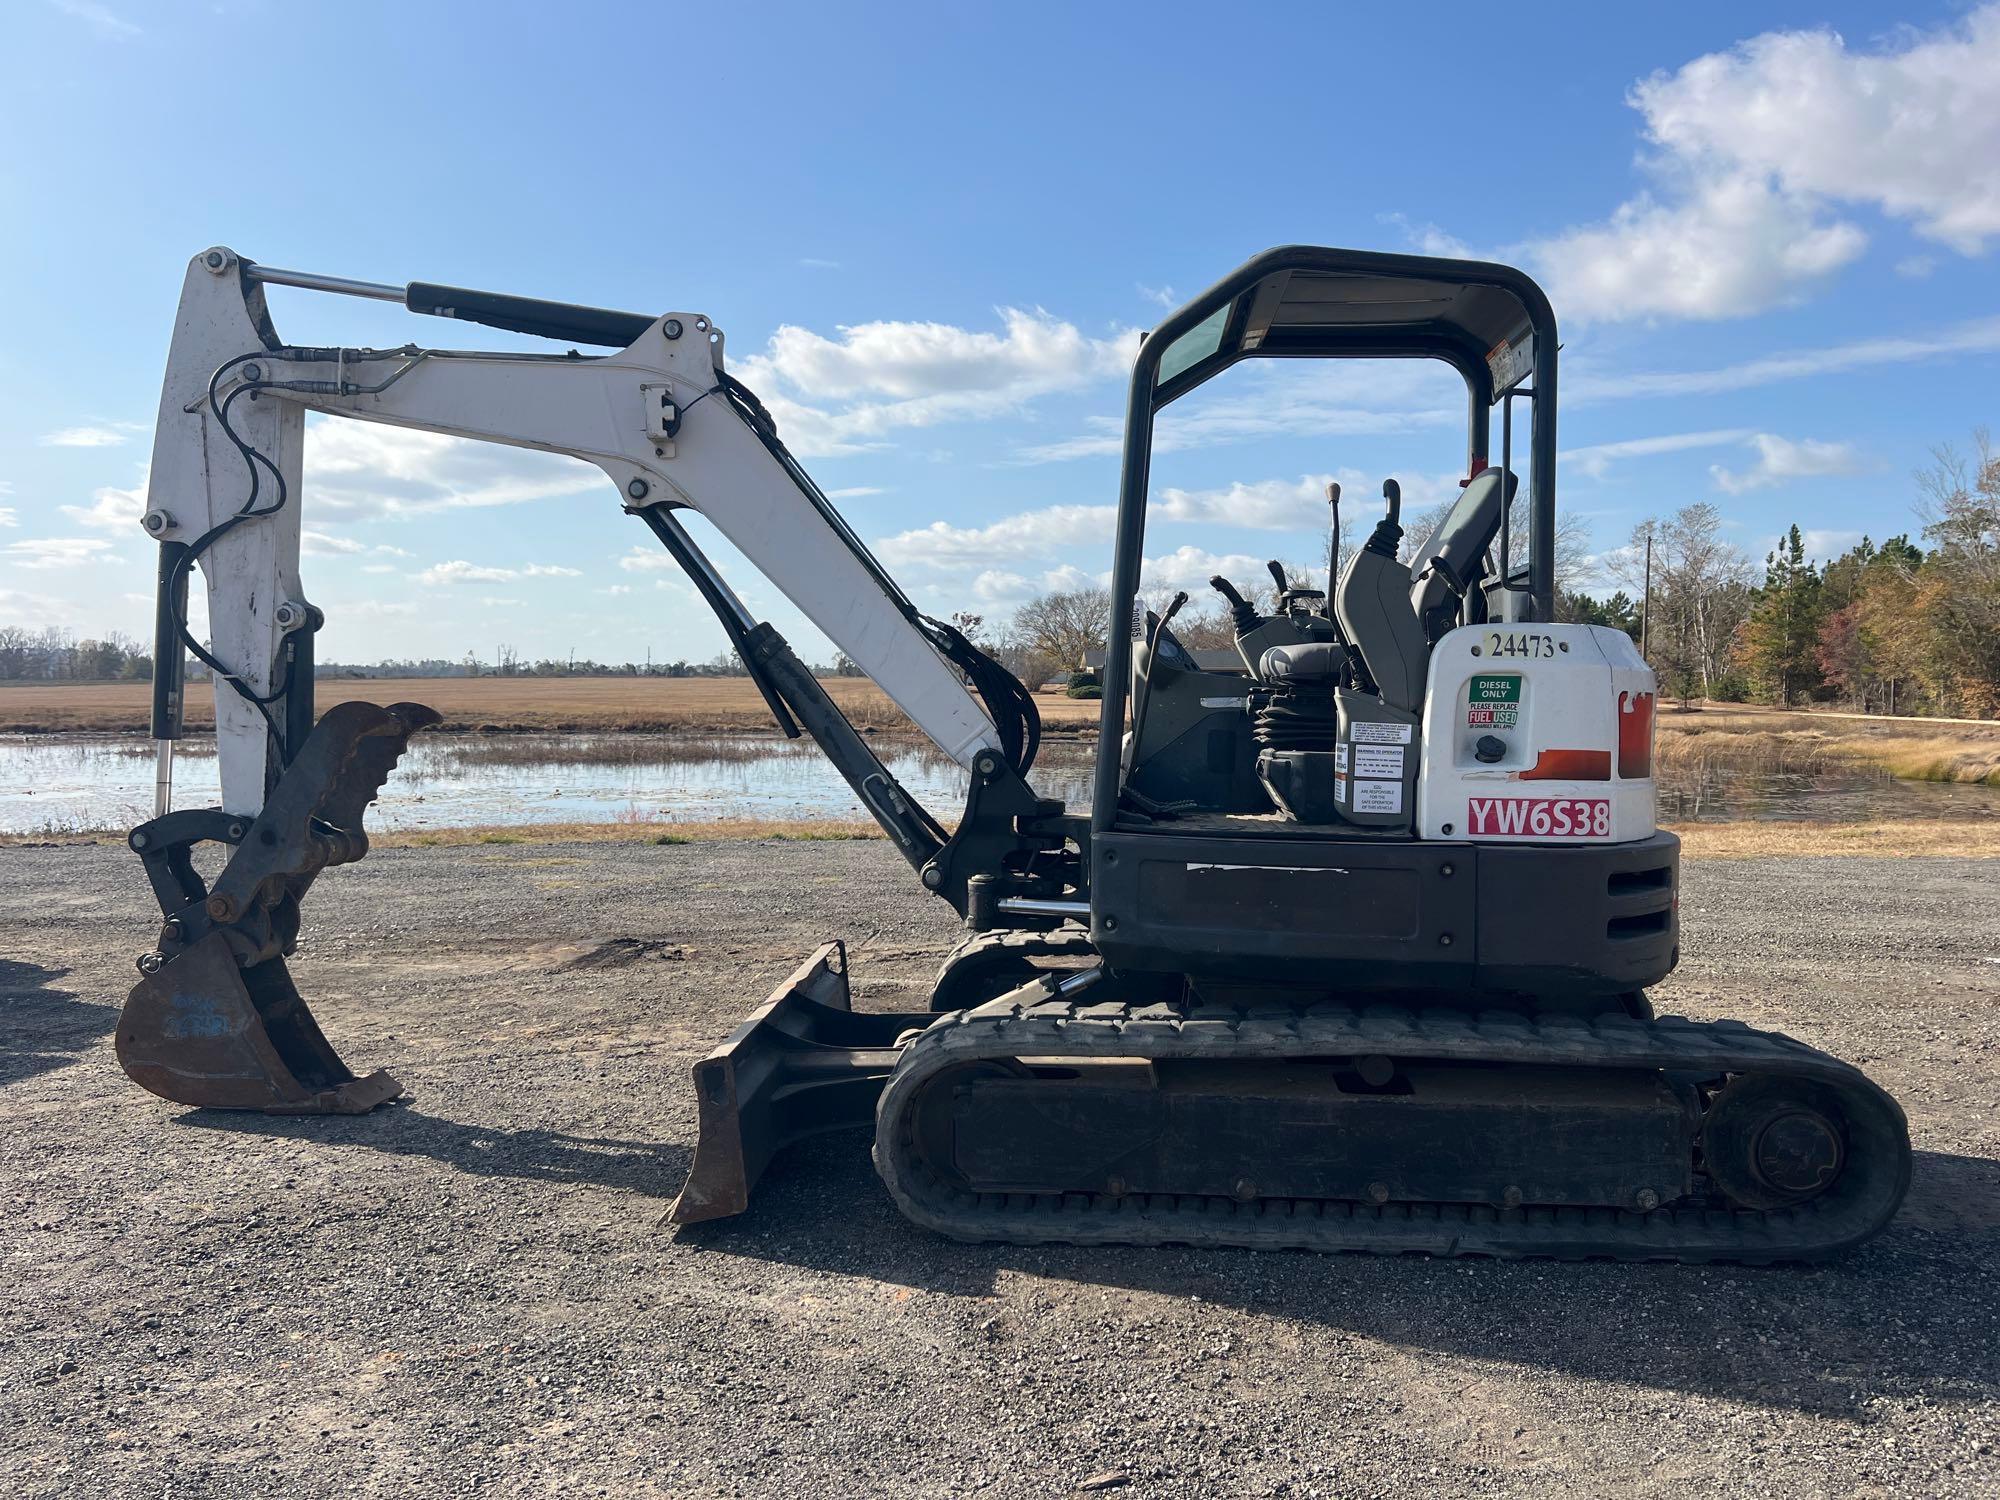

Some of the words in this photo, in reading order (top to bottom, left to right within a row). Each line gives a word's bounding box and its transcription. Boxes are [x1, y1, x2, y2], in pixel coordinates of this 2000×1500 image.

[1490, 633, 1555, 658] 24473
[1479, 681, 1512, 689] DIESEL
[1481, 690, 1507, 698] ONLY
[1469, 711, 1491, 723] FUEL
[1493, 711, 1517, 724] USED
[1469, 799, 1609, 836] YW6S38
